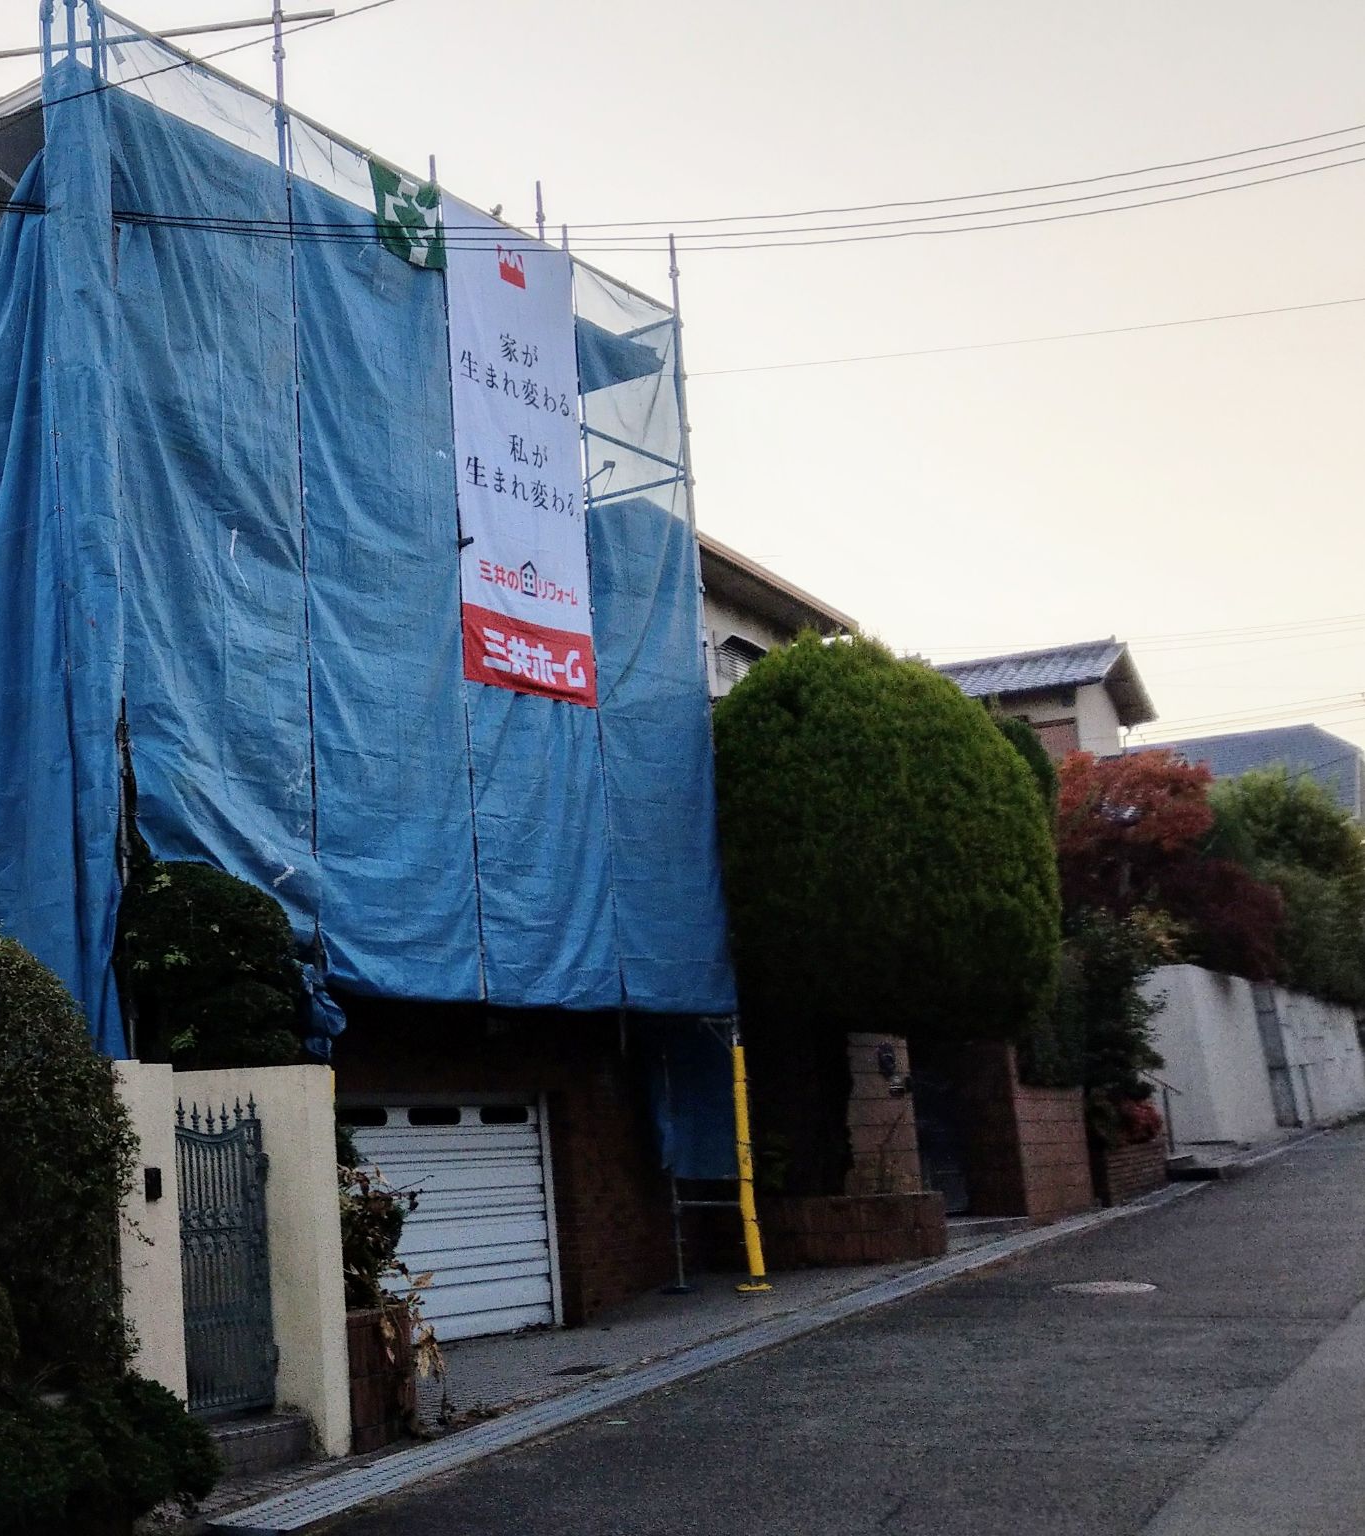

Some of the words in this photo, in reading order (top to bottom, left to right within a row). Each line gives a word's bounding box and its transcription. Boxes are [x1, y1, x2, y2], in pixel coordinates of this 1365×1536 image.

[499, 333, 538, 367] 家が
[508, 434, 548, 469] 私が
[482, 627, 587, 688] 三井ホーム
